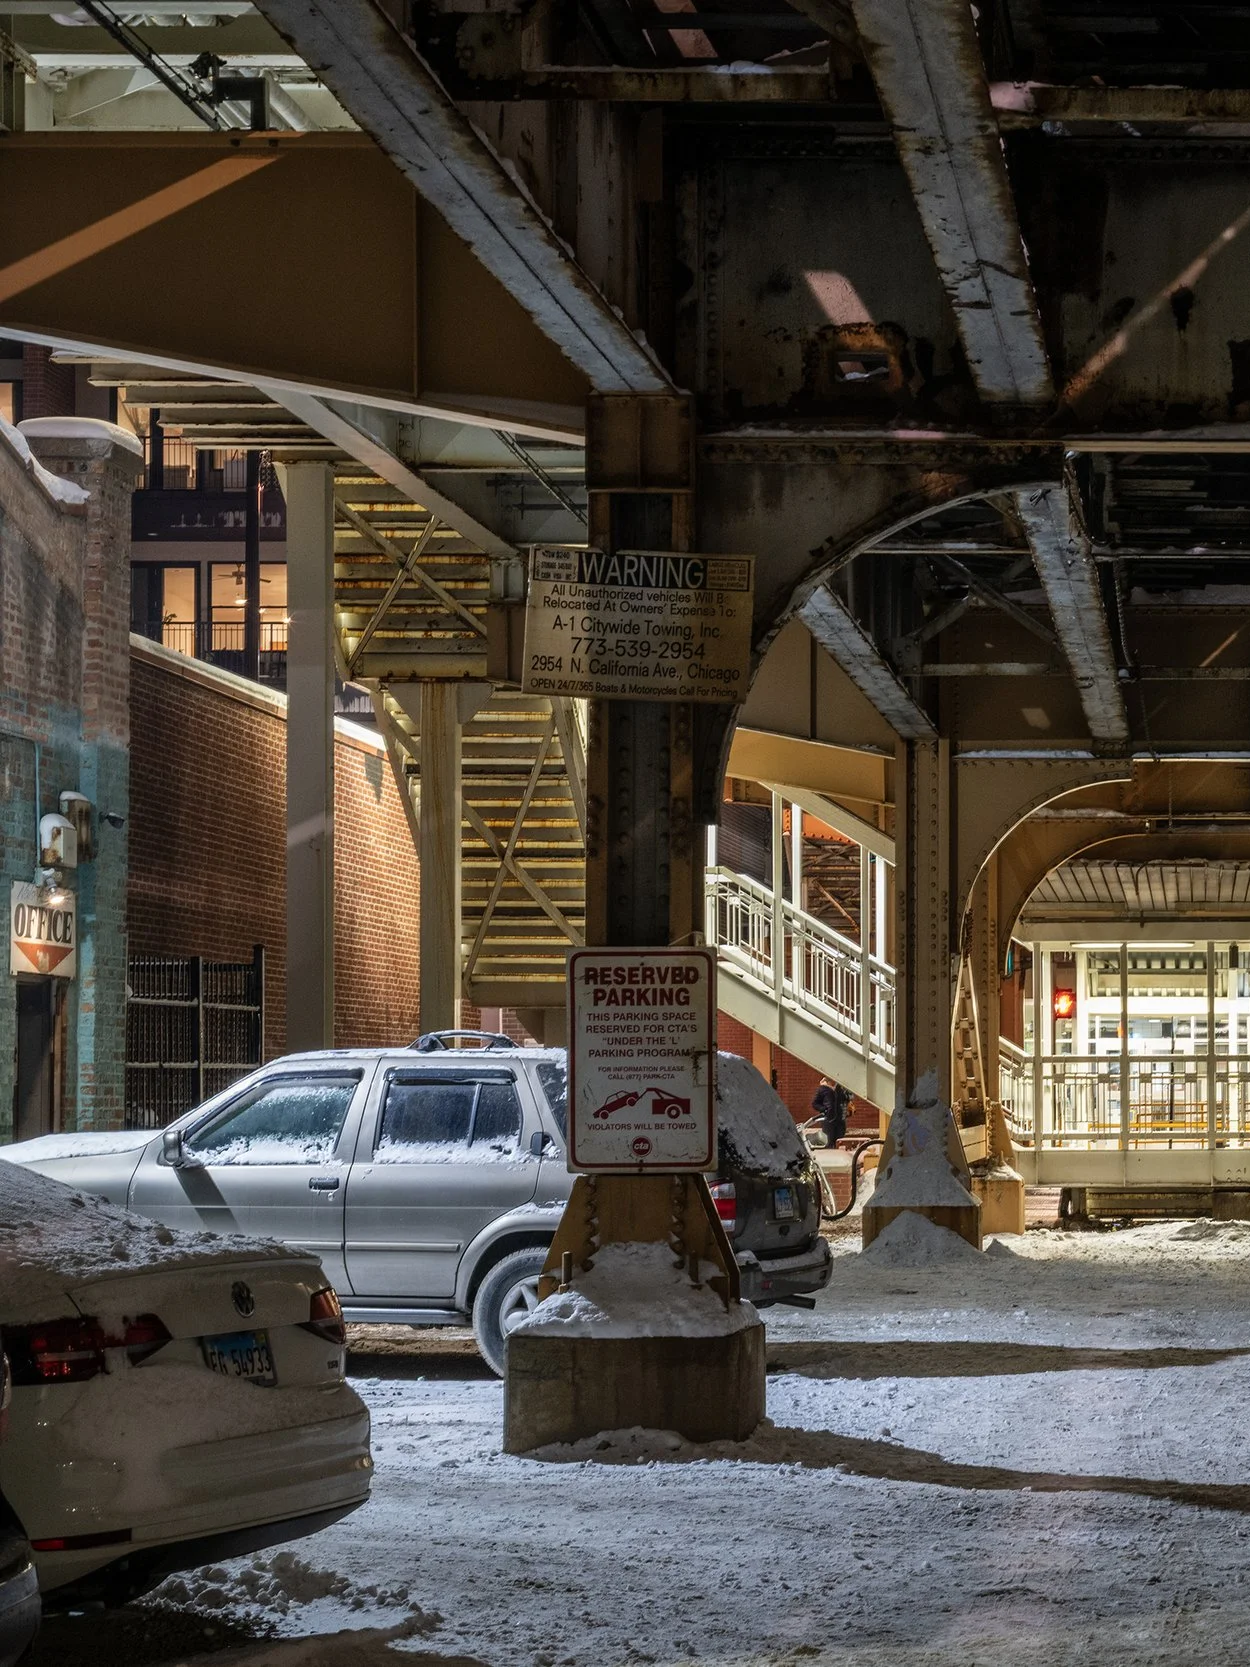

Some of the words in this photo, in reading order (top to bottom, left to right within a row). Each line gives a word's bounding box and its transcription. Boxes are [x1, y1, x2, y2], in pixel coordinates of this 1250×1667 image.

[581, 553, 704, 589] WARNING
[551, 584, 566, 596] All
[569, 586, 643, 601] Unauthorized
[647, 590, 691, 604] vehicles
[694, 592, 713, 604] Will
[543, 597, 600, 611] Relocated
[604, 601, 616, 612] At
[620, 602, 667, 615] Owners'
[670, 604, 716, 618] Expense
[552, 615, 575, 632] A-1
[581, 616, 640, 638] Citywide
[644, 620, 695, 640] Towing,
[571, 637, 706, 660] 773-539-2954
[532, 655, 563, 671] 2954
[570, 658, 584, 674] N.
[589, 659, 650, 678] California
[652, 663, 683, 680] Ave.,
[688, 664, 740, 684] Chicago
[530, 678, 555, 689] OPEN
[557, 679, 594, 692] 24/7/365
[596, 682, 618, 694] Boats
[620, 684, 626, 694] &
[628, 684, 677, 698] Motorcycles
[679, 686, 694, 696] Call
[697, 687, 710, 696] For
[711, 687, 738, 699] Pricing
[14, 903, 73, 944] OFFICE
[584, 967, 699, 985] RESERVED
[593, 988, 690, 1007] PARKING
[587, 1012, 610, 1021] THIS
[613, 1012, 659, 1021] PARKING
[662, 1012, 696, 1021] SPACE
[586, 1024, 640, 1034] RESERVED
[643, 1024, 664, 1034] FOR
[667, 1024, 697, 1034] CTA'S
[646, 1036, 665, 1046] THE
[588, 1049, 634, 1058] PARKING
[587, 1122, 632, 1130] VIOLATORS
[634, 1122, 652, 1130] WILL
[654, 1122, 665, 1130] BE
[668, 1122, 696, 1130] TOWED
[634, 1142, 650, 1150] cta
[231, 1346, 272, 1376] 54933
